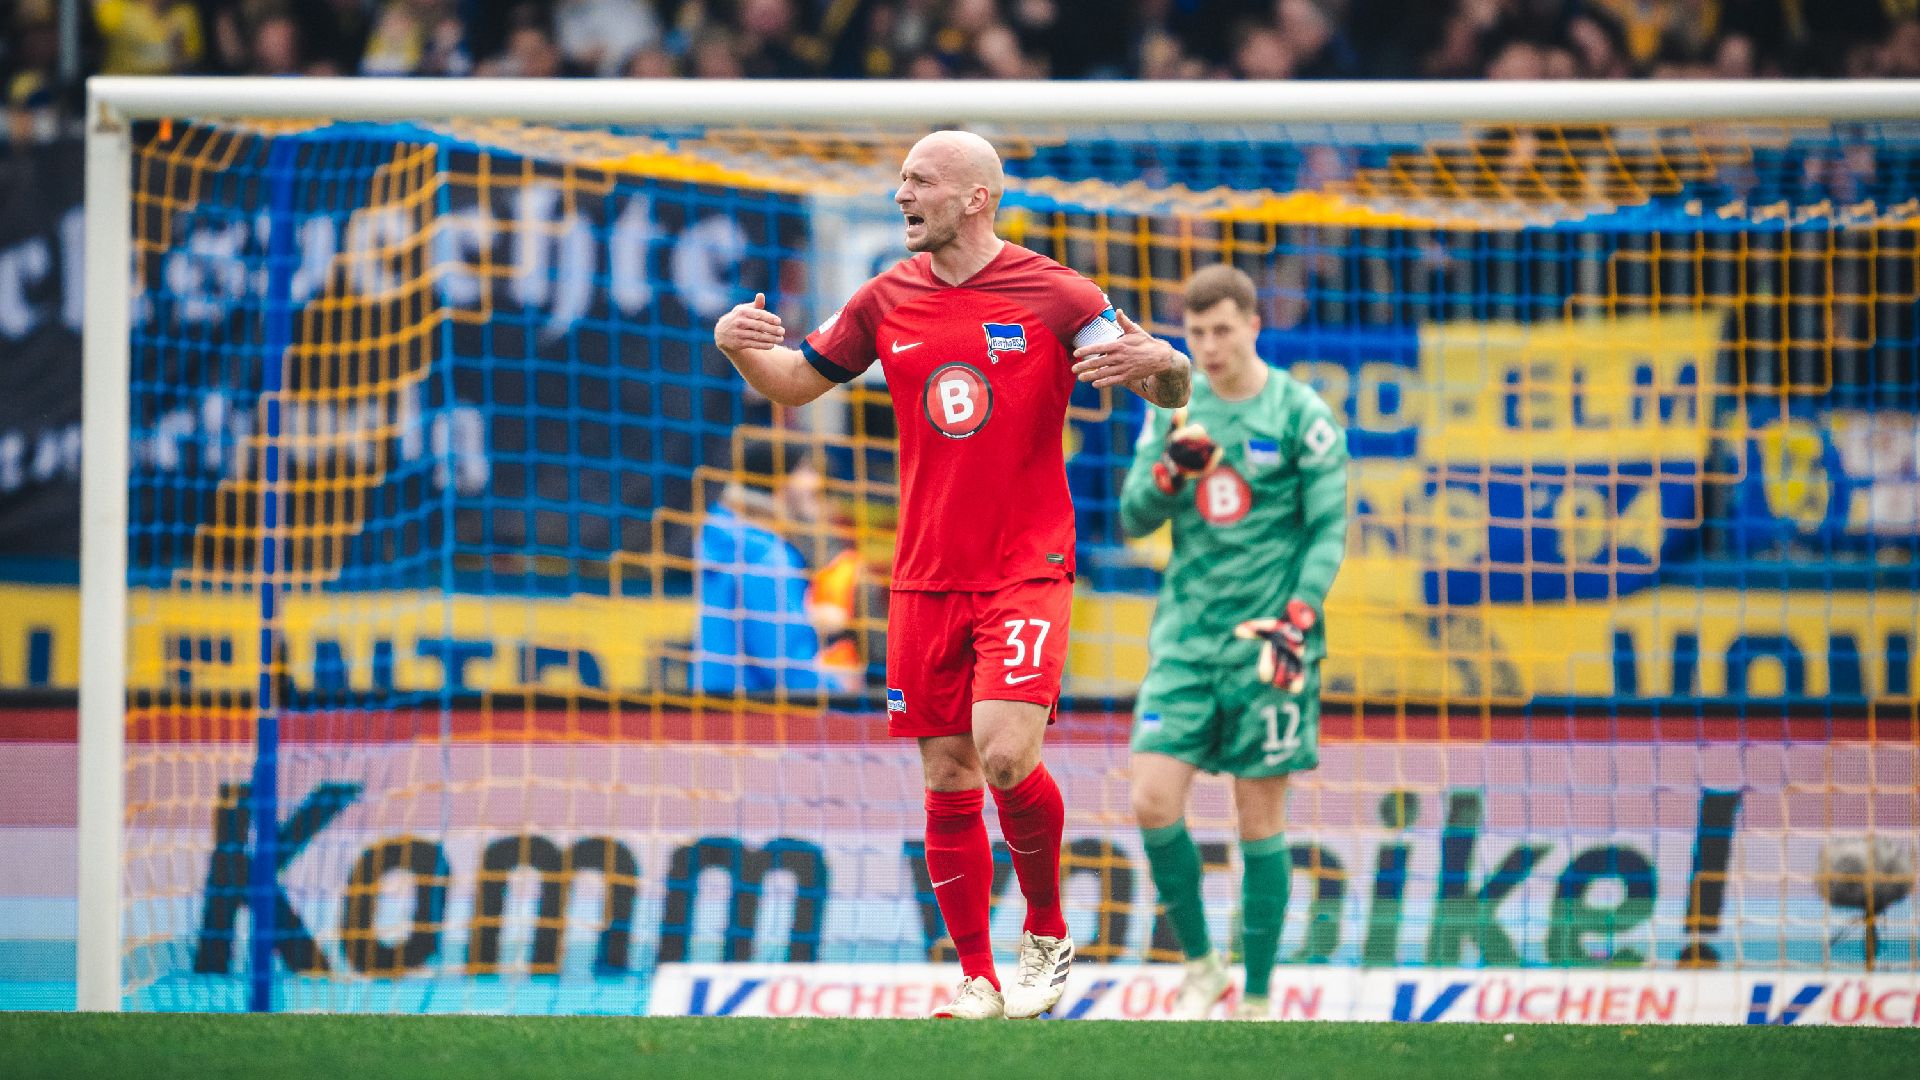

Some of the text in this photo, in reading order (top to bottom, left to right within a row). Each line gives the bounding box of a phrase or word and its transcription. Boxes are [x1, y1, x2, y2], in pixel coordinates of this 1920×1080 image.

[940, 380, 974, 425] B
[1207, 475, 1240, 517] B
[1003, 618, 1051, 668] 37
[1260, 702, 1301, 752] 12
[194, 780, 833, 976] Komm
